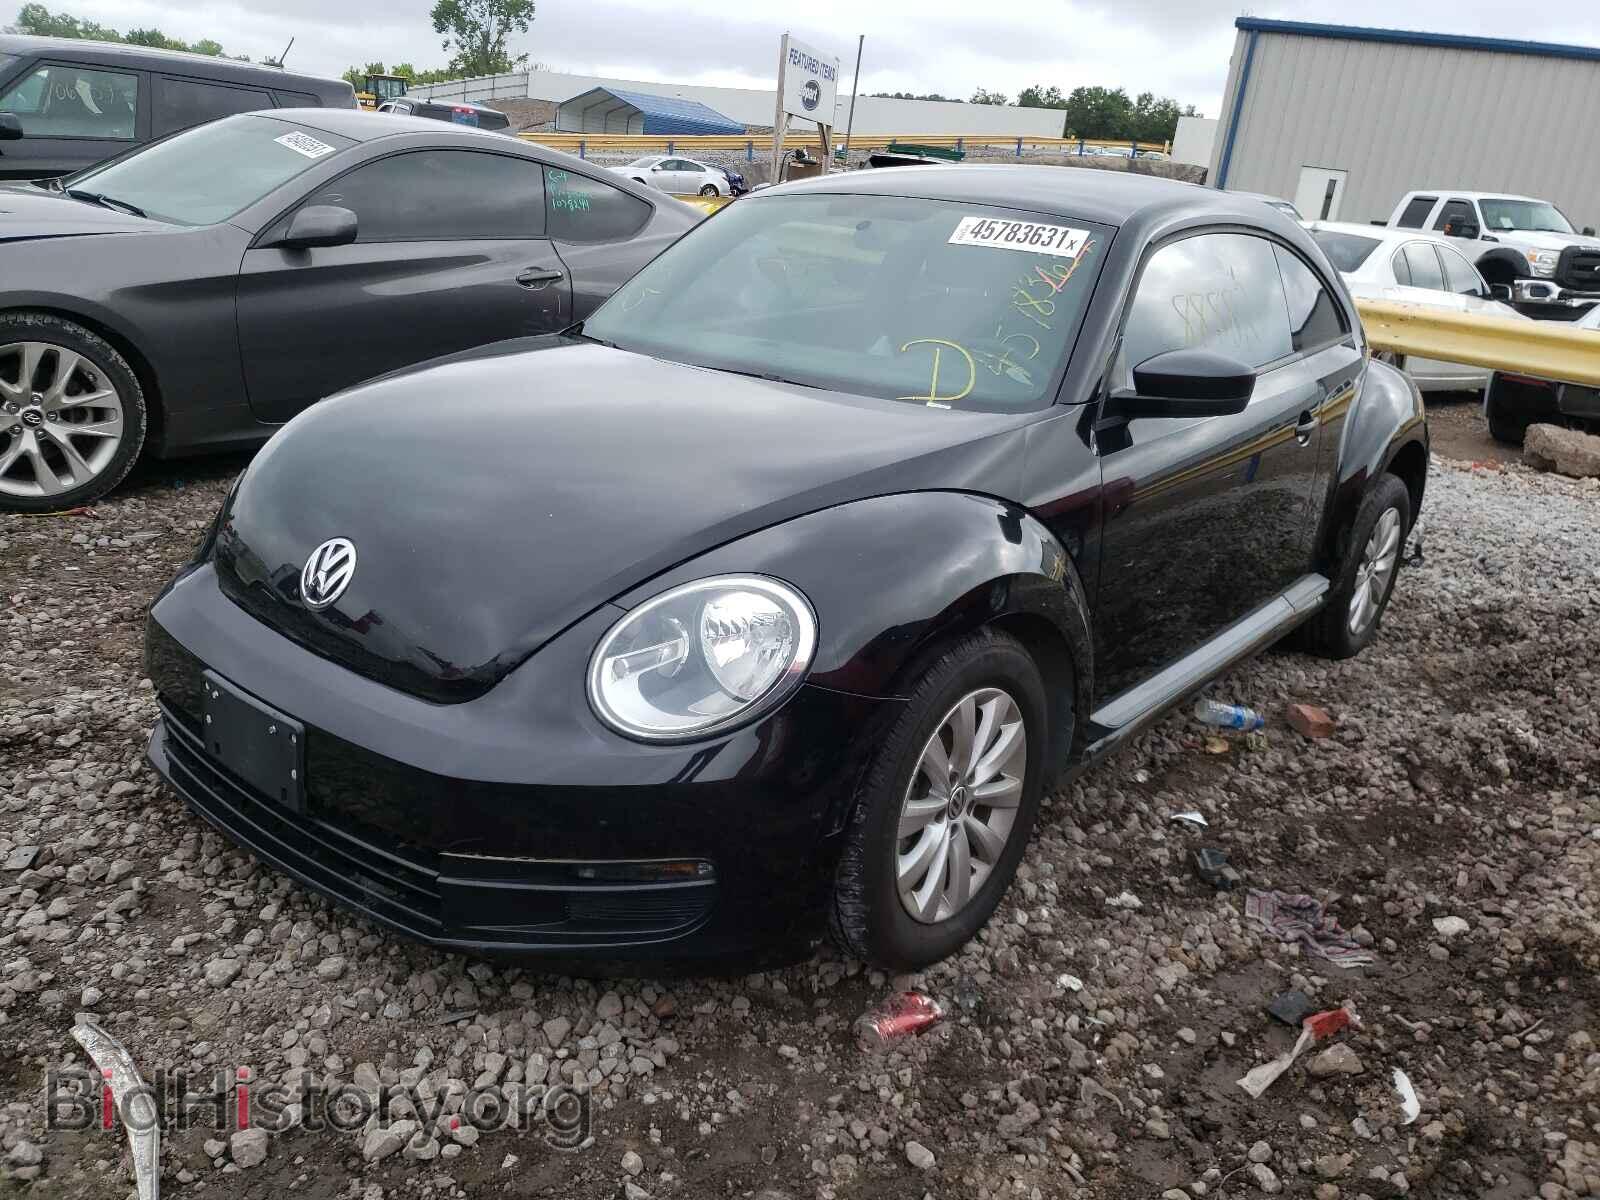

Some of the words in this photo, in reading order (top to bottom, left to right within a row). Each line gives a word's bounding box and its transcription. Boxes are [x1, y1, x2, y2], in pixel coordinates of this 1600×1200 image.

[788, 47, 819, 74] FEATURED
[970, 219, 1069, 249] 45783631
[896, 339, 976, 404] D
